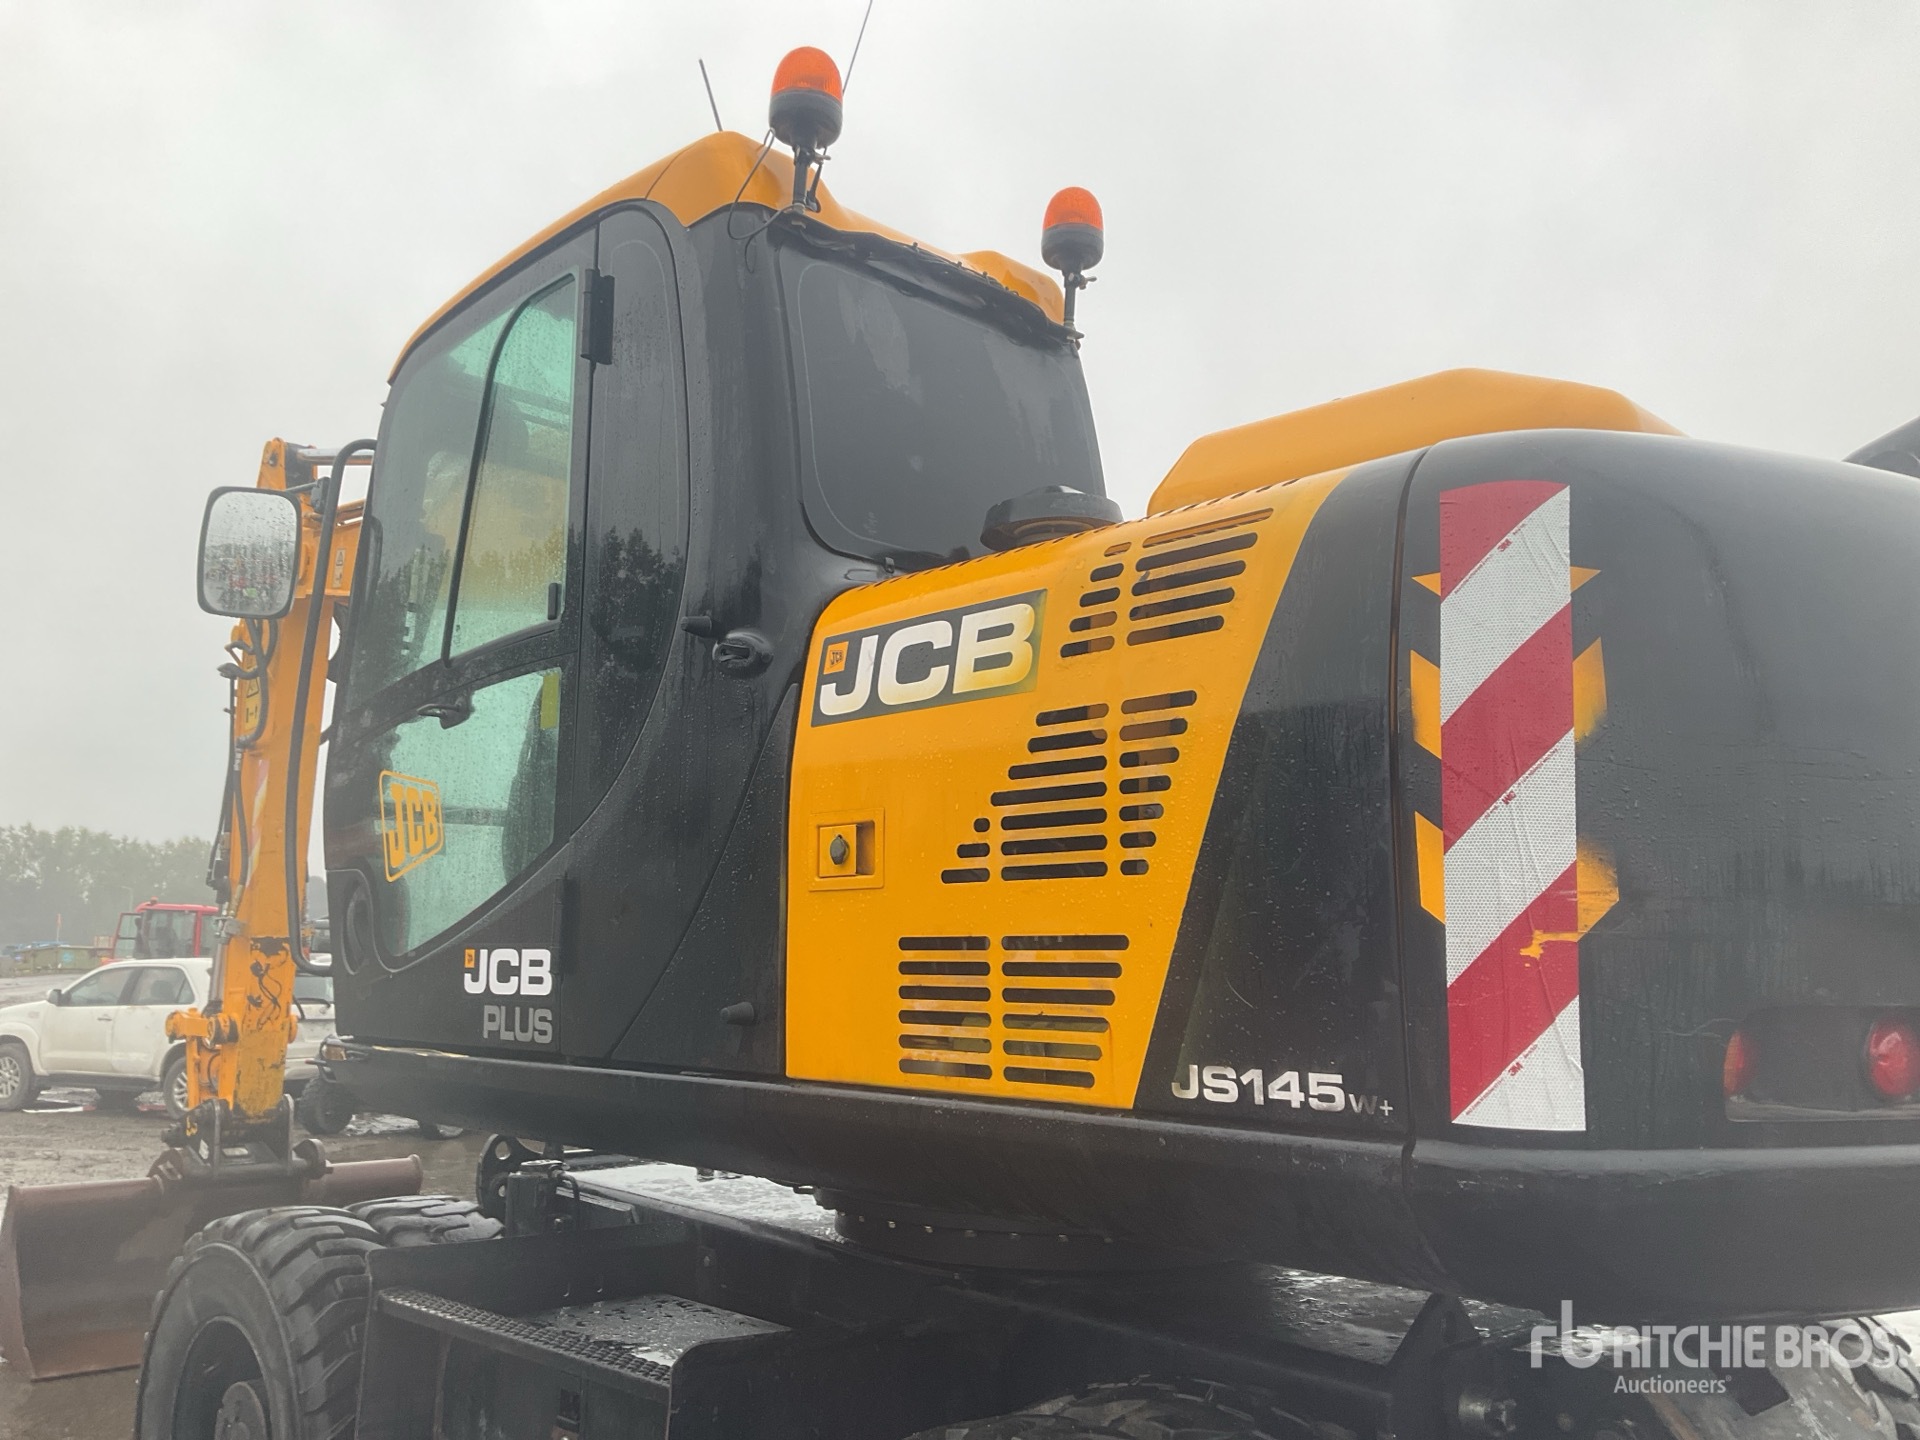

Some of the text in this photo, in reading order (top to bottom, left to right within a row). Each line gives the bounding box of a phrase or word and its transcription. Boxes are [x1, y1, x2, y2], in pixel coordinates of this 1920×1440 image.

[819, 603, 1036, 716] JCB
[388, 783, 439, 868] JCB
[464, 949, 552, 995] JCB
[483, 1004, 552, 1043] PLUS
